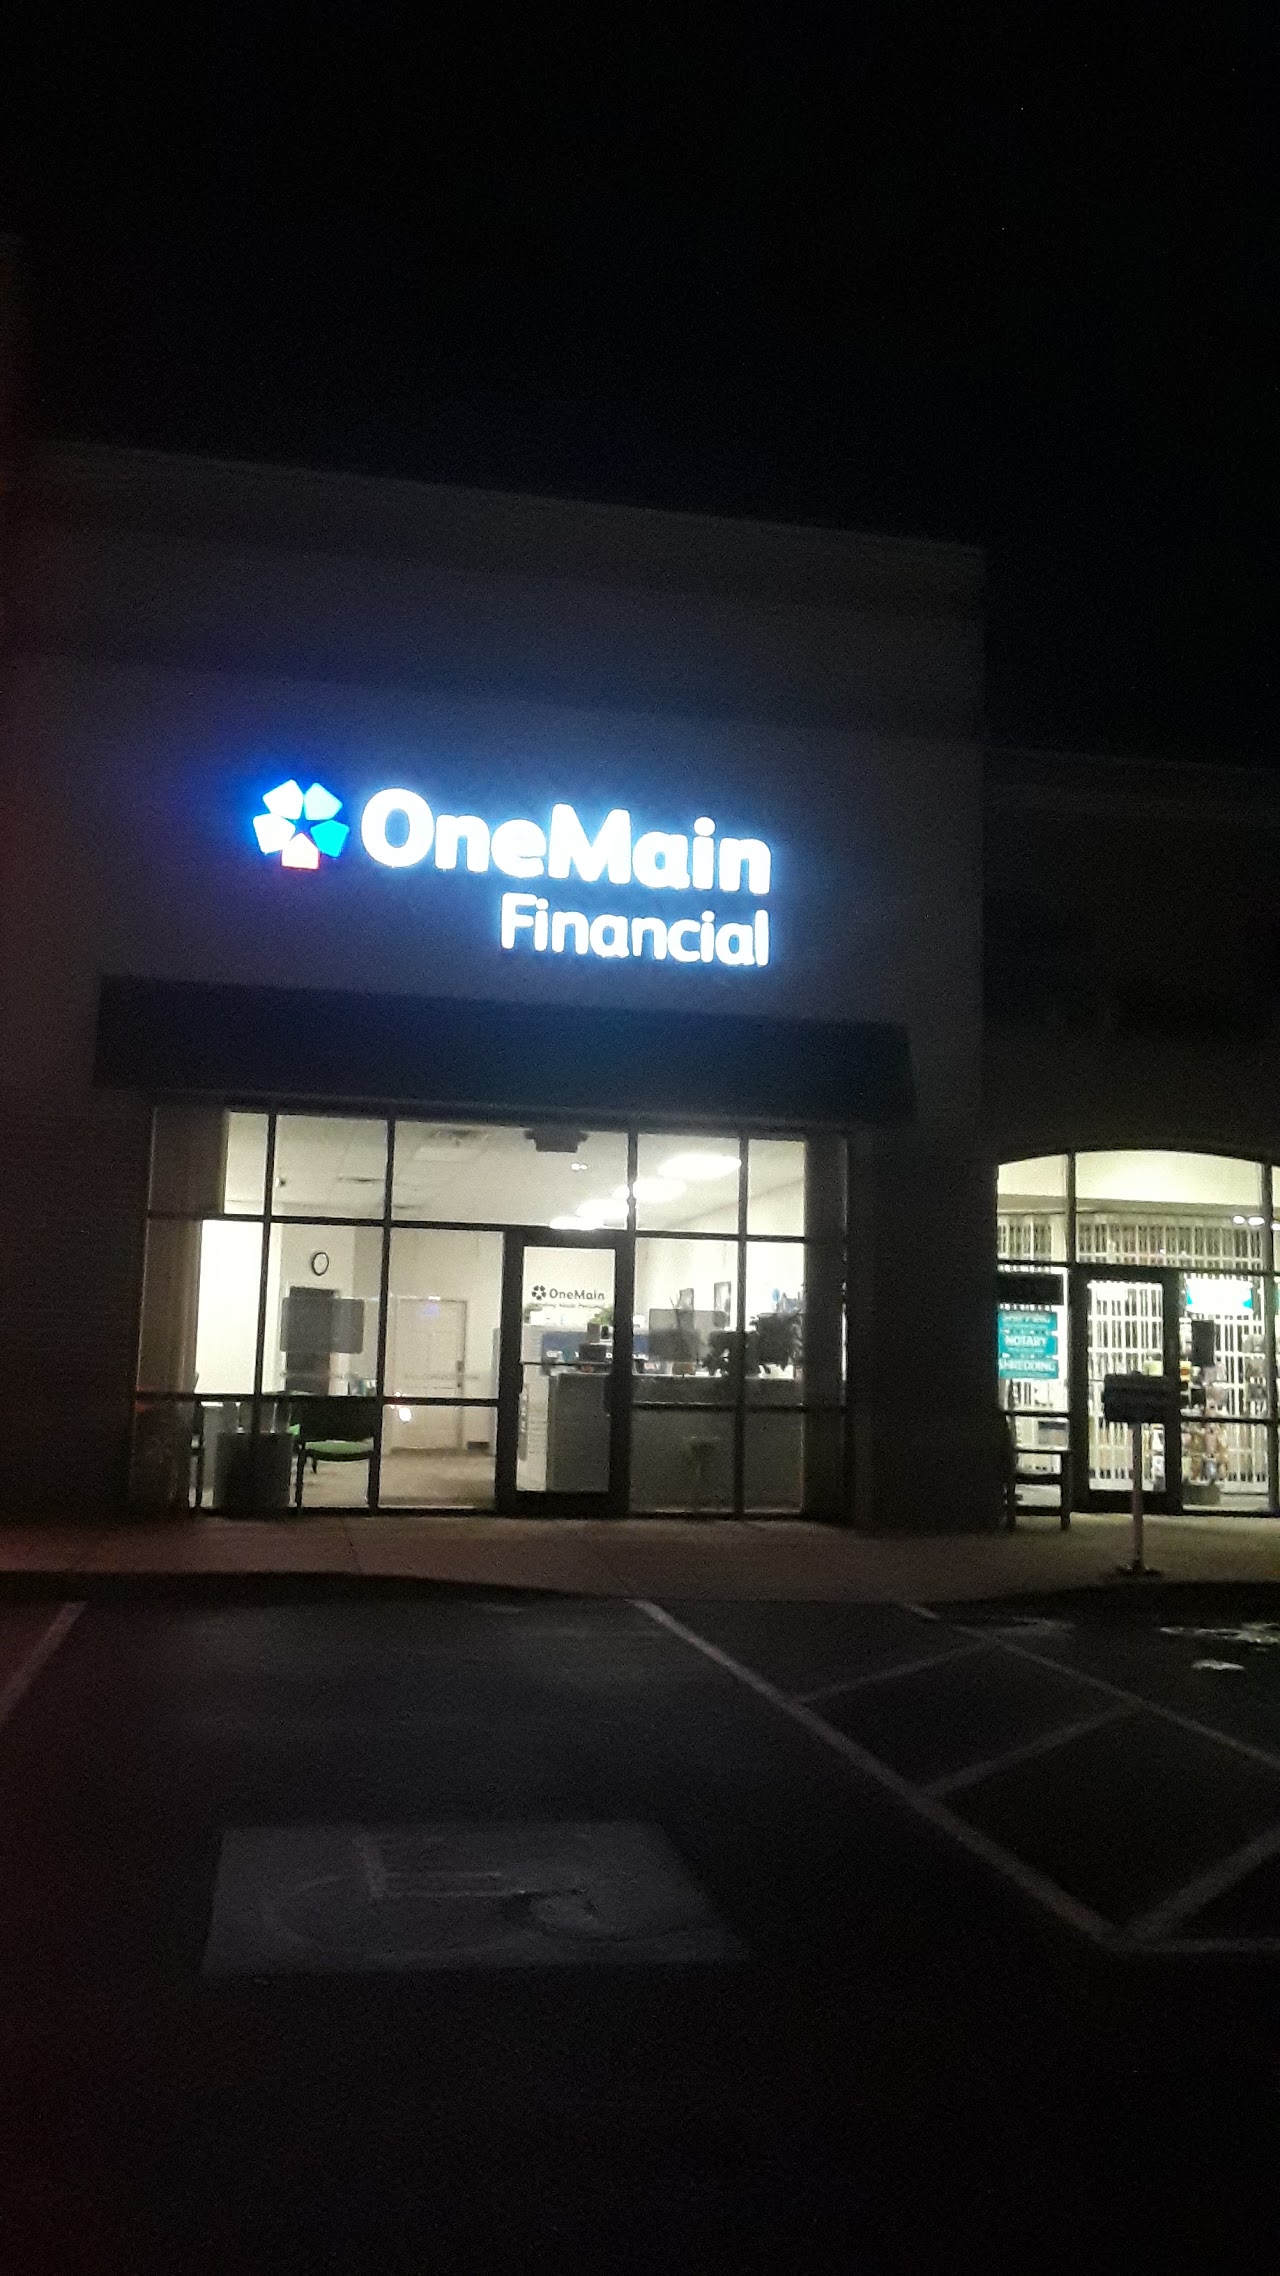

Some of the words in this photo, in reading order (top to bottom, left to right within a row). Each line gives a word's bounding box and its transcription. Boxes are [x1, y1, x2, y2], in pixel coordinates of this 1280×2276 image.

[360, 788, 772, 895] OneMain
[501, 892, 770, 967] Financial
[549, 1288, 605, 1300] OneMain
[1005, 1335, 1046, 1348] NOTARY
